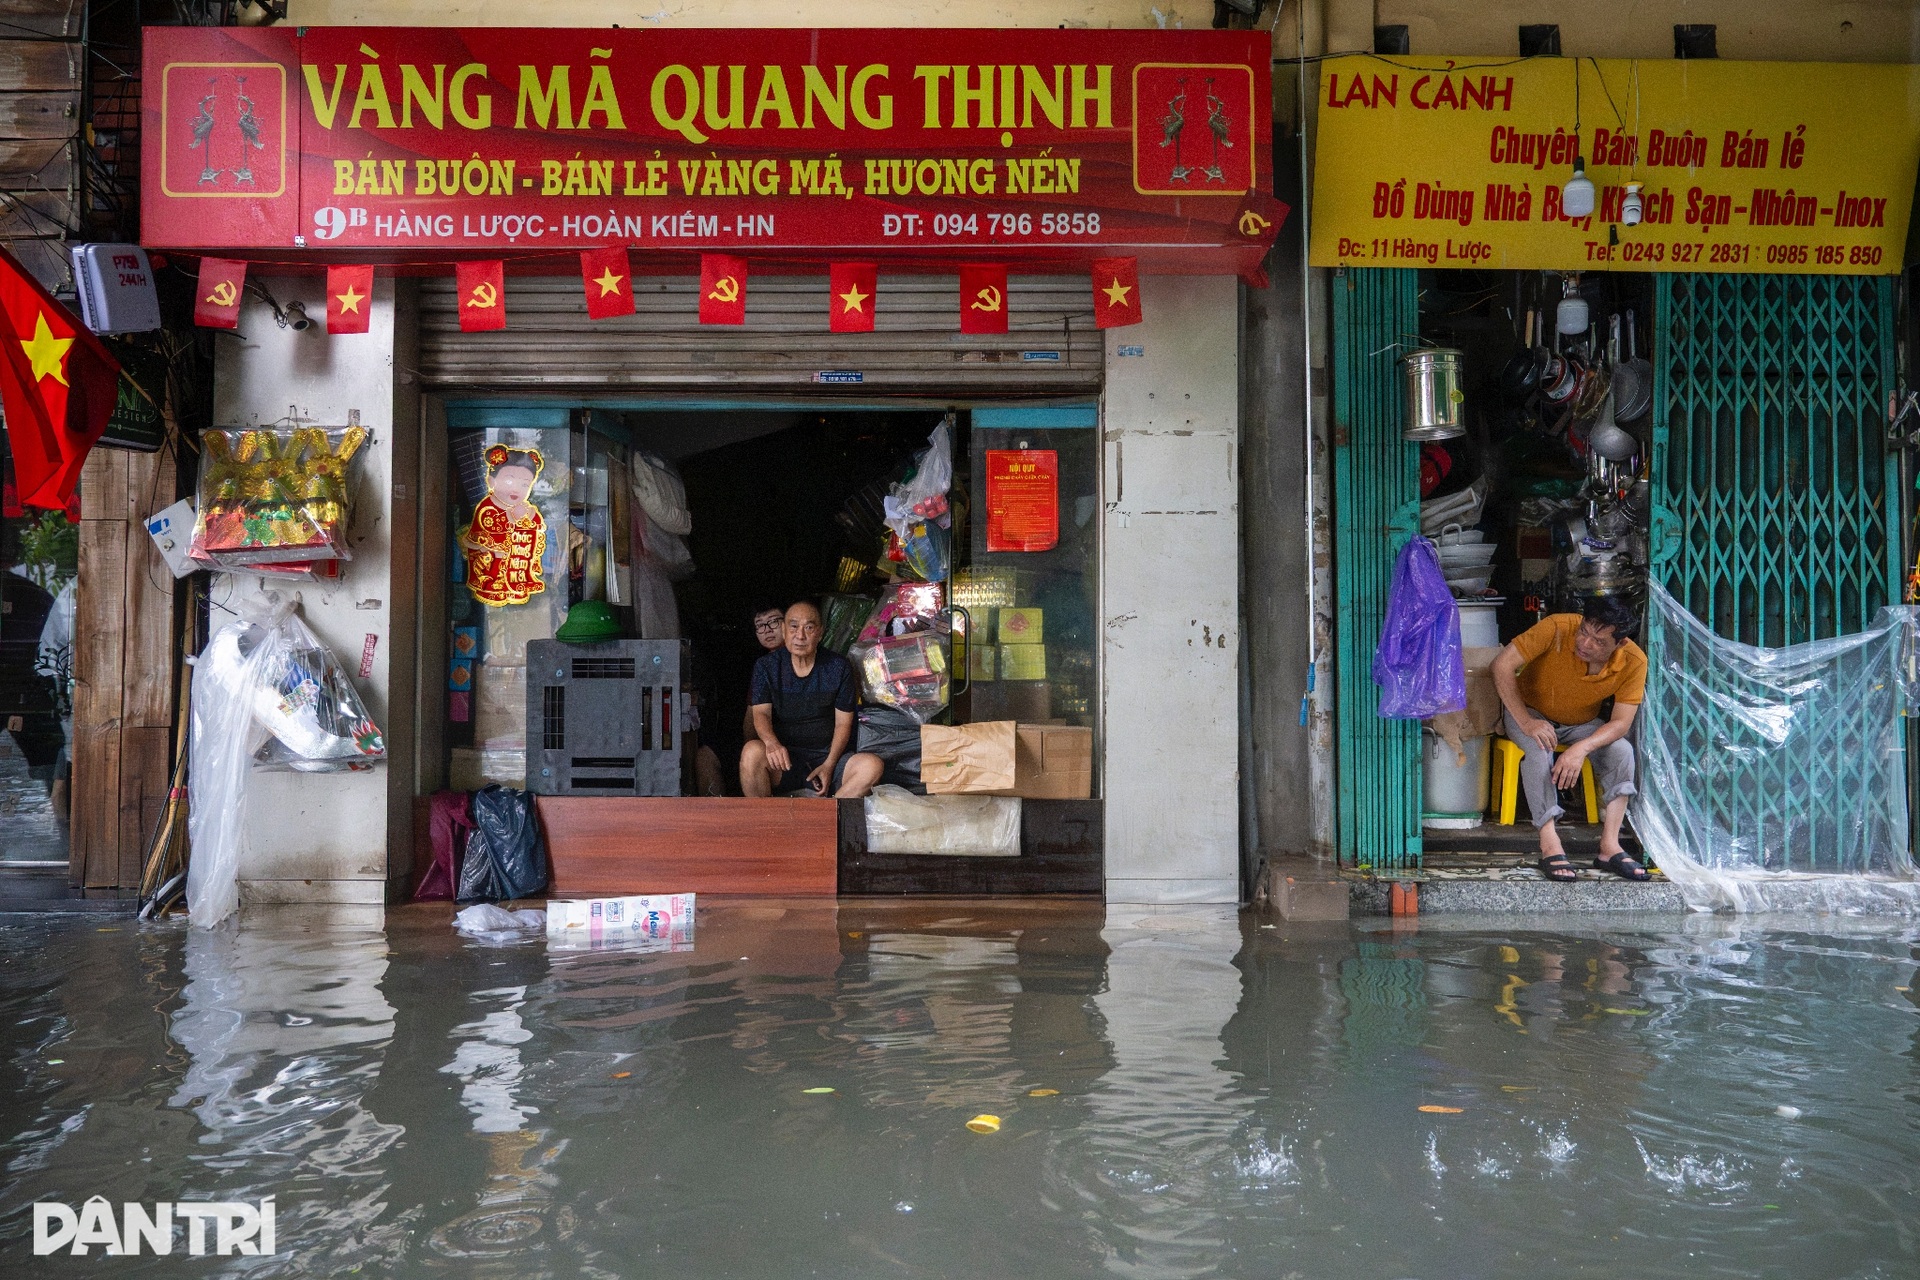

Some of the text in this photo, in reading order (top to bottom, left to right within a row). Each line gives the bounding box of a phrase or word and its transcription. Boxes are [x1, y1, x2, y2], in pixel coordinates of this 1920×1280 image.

[302, 44, 1113, 148] VÀNG MÃ QUANG THỊNH
[1327, 60, 1514, 111] LAN CẢNH
[1490, 124, 1807, 170] Chuyên Bán Buôn Bán lẻ
[334, 152, 407, 196] BÁN
[415, 152, 516, 196] BUÔN
[542, 152, 615, 196] BÁN
[624, 150, 668, 196] LẺ
[678, 152, 780, 196] VÀNG
[790, 152, 854, 200] MÃ,
[865, 158, 996, 196] HƯƠNG
[1005, 147, 1081, 195] NẾN
[374, 209, 454, 238] HÀNG
[882, 213, 1101, 237] ĐT: 094 796 5858
[1373, 178, 1407, 219] Đồ
[1413, 181, 1474, 226] Dùng
[1483, 183, 1531, 221] Nhà
[1338, 238, 1366, 258] Đc:
[1393, 238, 1438, 264] Hàng
[1446, 240, 1491, 264] Lược
[1585, 242, 1615, 262] Tel:
[1623, 242, 1664, 263] 0243
[1671, 242, 1704, 263] 927
[1710, 243, 1750, 263] 2831
[1767, 244, 1808, 264] 0985
[1815, 245, 1844, 265] 185
[1849, 246, 1883, 266] 850
